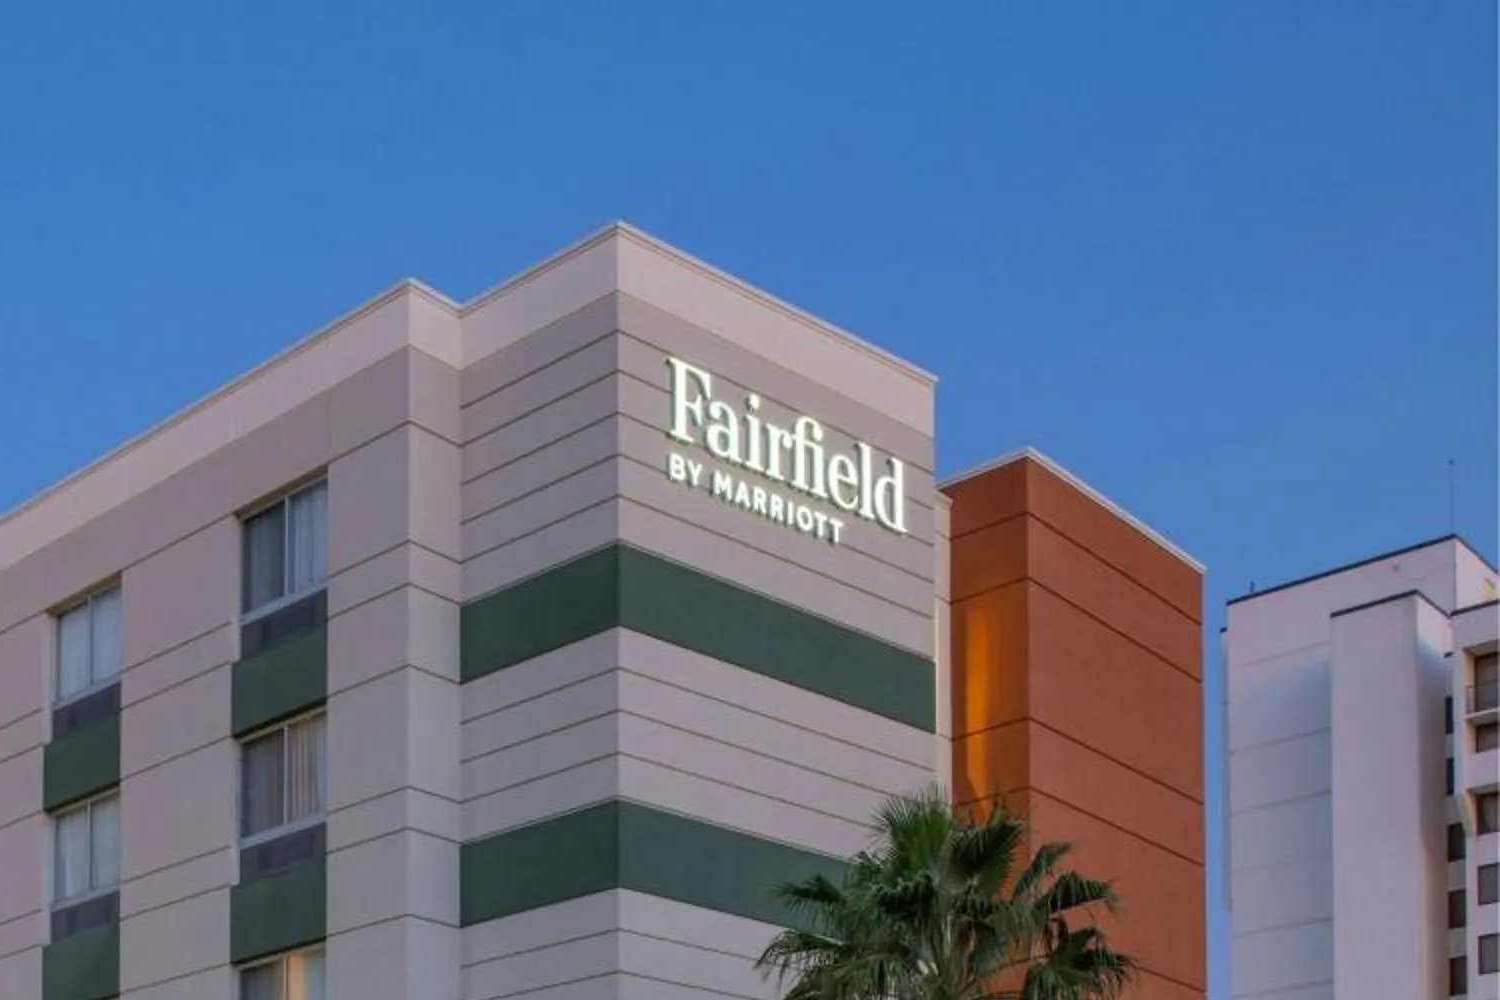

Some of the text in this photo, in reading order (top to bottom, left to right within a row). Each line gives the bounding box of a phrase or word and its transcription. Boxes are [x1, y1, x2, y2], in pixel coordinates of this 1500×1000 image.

[665, 357, 908, 534] Fairfield
[667, 452, 844, 543] BY MARRIOTT
